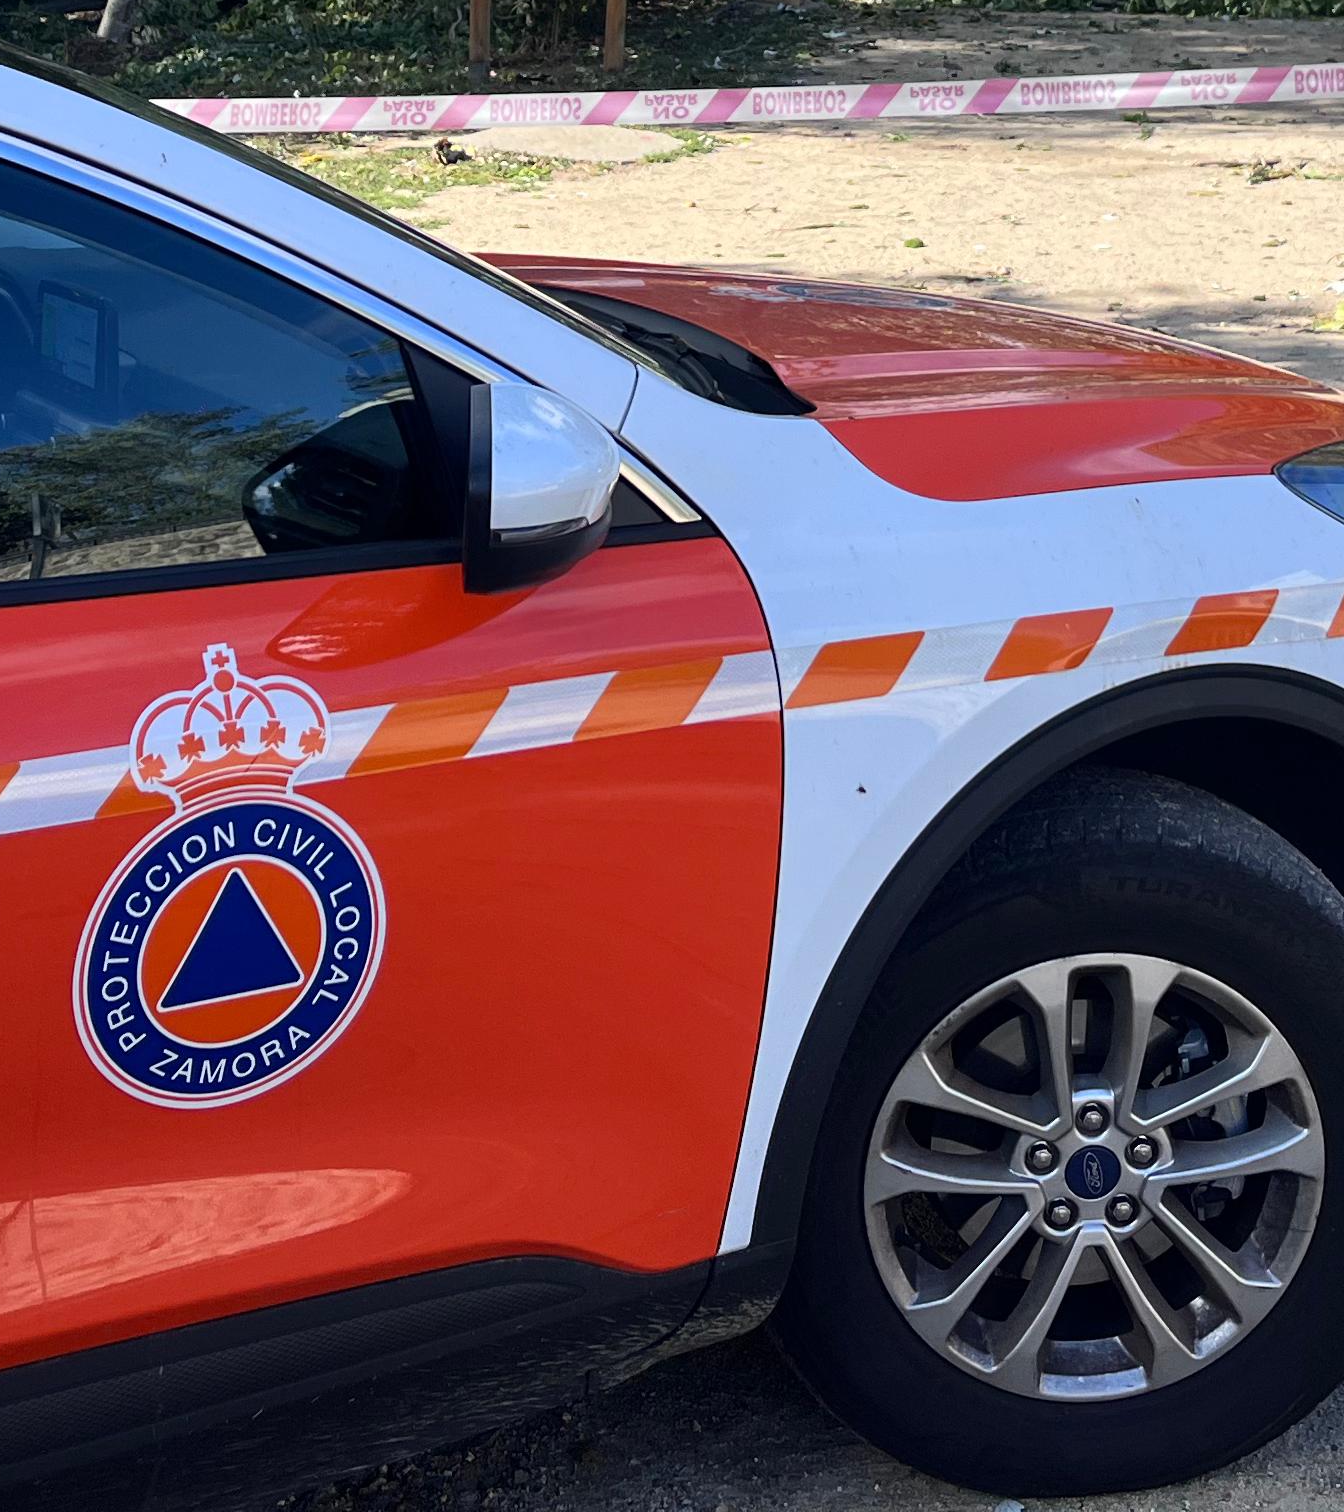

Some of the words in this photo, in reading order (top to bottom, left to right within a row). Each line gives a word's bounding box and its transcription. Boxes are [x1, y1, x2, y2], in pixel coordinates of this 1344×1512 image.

[101, 821, 236, 1053] PROTECCION
[254, 818, 335, 881] CIVIL
[311, 881, 361, 1007] LOCAL
[149, 1024, 312, 1085] ZAMORA
